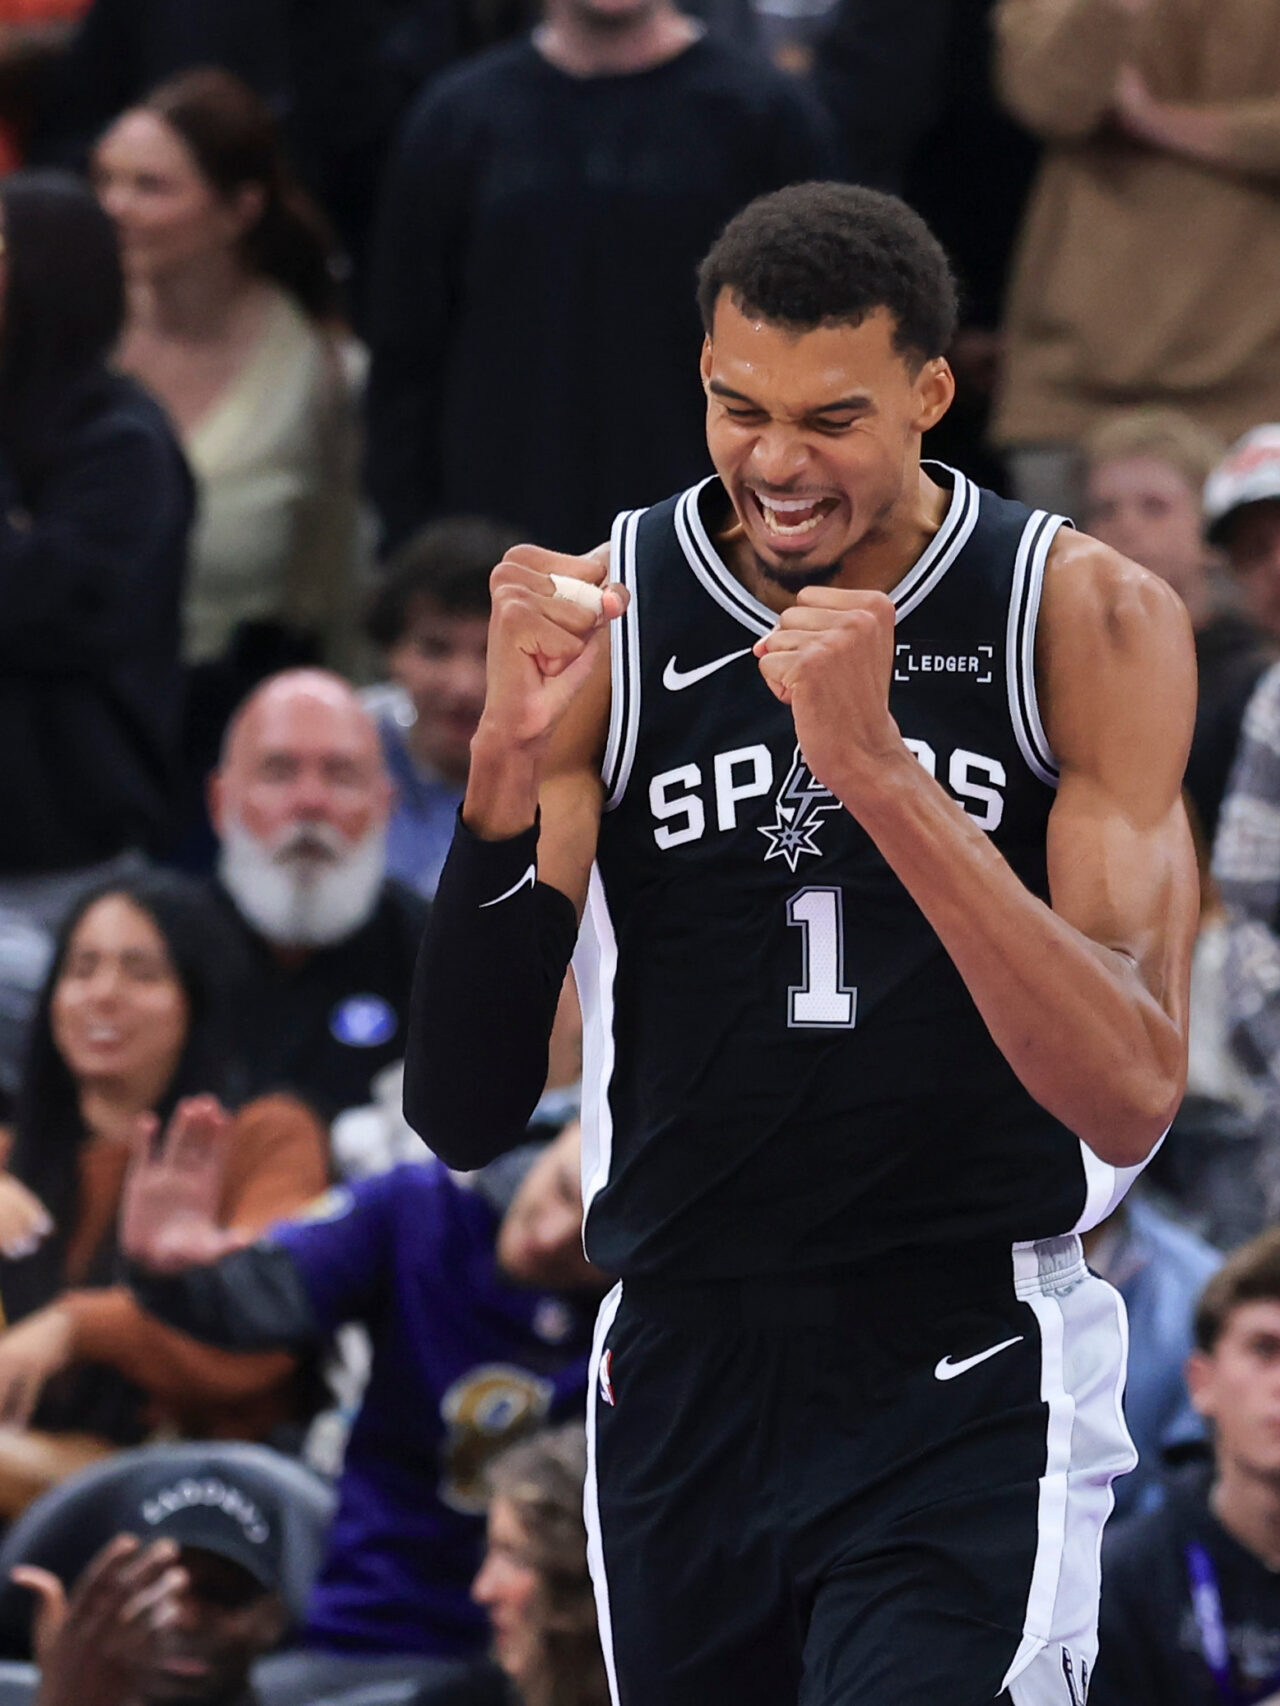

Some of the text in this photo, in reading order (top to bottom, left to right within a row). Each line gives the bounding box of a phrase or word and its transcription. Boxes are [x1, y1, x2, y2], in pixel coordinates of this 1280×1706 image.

[908, 655, 979, 672] LEDGER
[649, 737, 1007, 872] SPS
[786, 886, 857, 1028] 1
